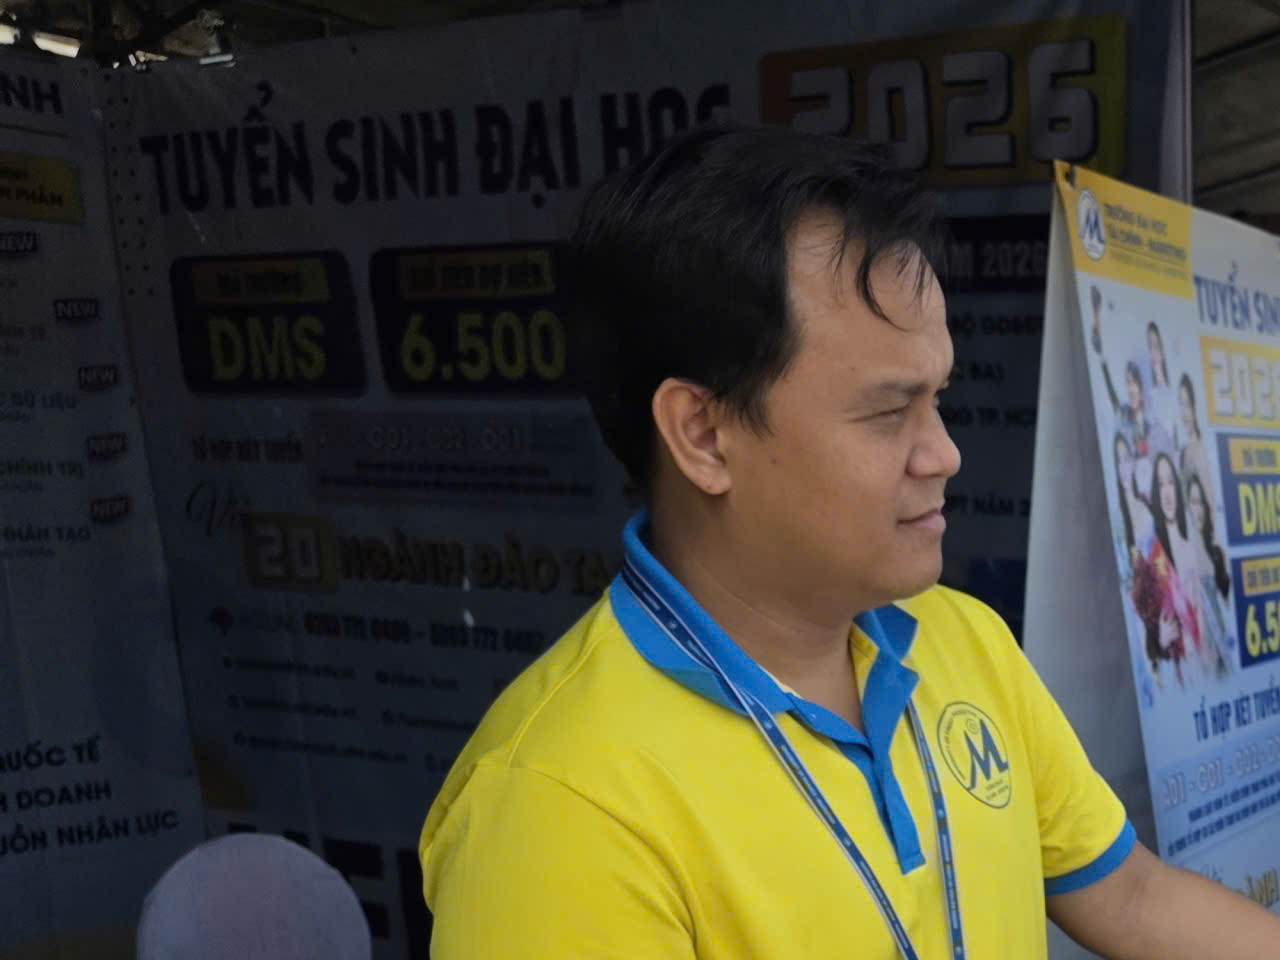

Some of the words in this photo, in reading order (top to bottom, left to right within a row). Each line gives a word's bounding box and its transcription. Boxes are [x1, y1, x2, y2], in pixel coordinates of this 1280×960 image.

[791, 40, 1098, 171] 2026
[139, 79, 313, 215] TUYỂN
[325, 107, 458, 206] SINH
[474, 96, 580, 209] ĐẠI
[1194, 261, 1251, 331] TUYỂN
[207, 316, 326, 381] DMS
[401, 308, 566, 382] 6.500
[16, 779, 113, 812] DOANH
[56, 812, 130, 848] NHÂN
[135, 808, 180, 838] LỰC
